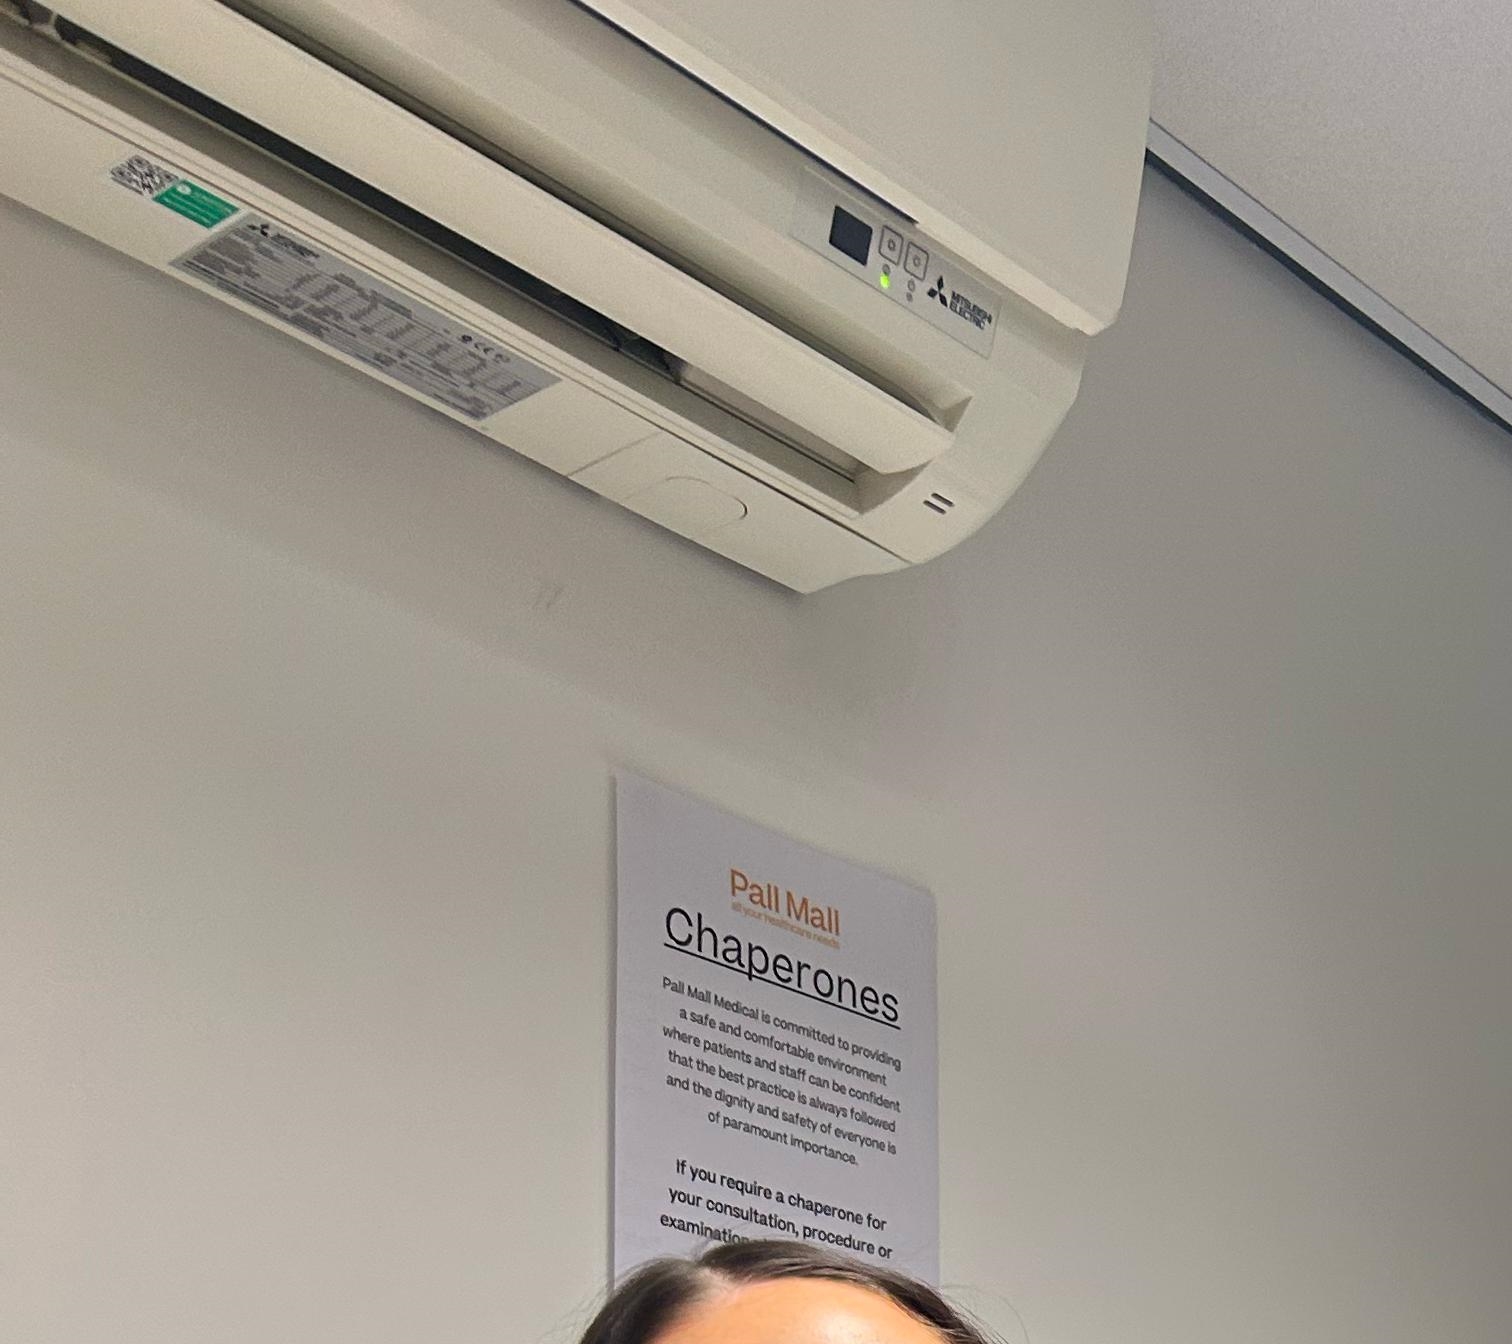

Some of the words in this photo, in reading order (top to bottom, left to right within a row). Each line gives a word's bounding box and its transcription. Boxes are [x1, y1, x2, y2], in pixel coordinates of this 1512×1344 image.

[730, 868, 779, 913] Pall
[786, 890, 840, 936] Mall
[665, 907, 899, 1022] Chaperones
[663, 976, 684, 994] Pall
[688, 985, 711, 1004] Mall
[714, 994, 758, 1019] Medical
[762, 1010, 770, 1024] is
[773, 1017, 834, 1046] committed
[838, 1037, 849, 1050] to
[852, 1043, 901, 1072] providing
[680, 1008, 688, 1020] a
[690, 1012, 716, 1028] safe
[719, 1022, 742, 1037] and
[744, 1030, 814, 1062] comfortable
[818, 1054, 886, 1086] environment
[663, 1026, 700, 1047] where
[704, 1040, 752, 1064] patients
[754, 1056, 776, 1072] and
[779, 1064, 806, 1081] staff
[808, 1075, 830, 1088] can
[832, 1080, 846, 1095] be
[849, 1088, 901, 1112] confident
[668, 1050, 693, 1069] that
[696, 1059, 716, 1076] the
[719, 1064, 744, 1085] best
[747, 1077, 795, 1101] practice
[798, 1091, 806, 1104] is
[809, 1096, 848, 1118] always
[850, 1107, 896, 1132] followed
[666, 1075, 690, 1090] and
[693, 1082, 712, 1098] the
[715, 1088, 755, 1114] dignity
[757, 1104, 779, 1119] and
[782, 1111, 818, 1132] safety
[820, 1123, 832, 1134] of
[834, 1127, 886, 1152] everyone
[888, 1141, 896, 1154] is
[708, 1111, 720, 1124] of
[723, 1116, 788, 1146] paramount
[790, 1134, 859, 1166] importance.
[668, 1188, 702, 1207] your
[706, 1199, 799, 1238] consultation,
[802, 1225, 875, 1254] procedure
[878, 1246, 893, 1259] or
[676, 1159, 686, 1175] If
[690, 1165, 716, 1184] you
[720, 1174, 772, 1200] require
[776, 1191, 784, 1204] a
[788, 1193, 864, 1224] chaperone
[866, 1213, 887, 1231] for
